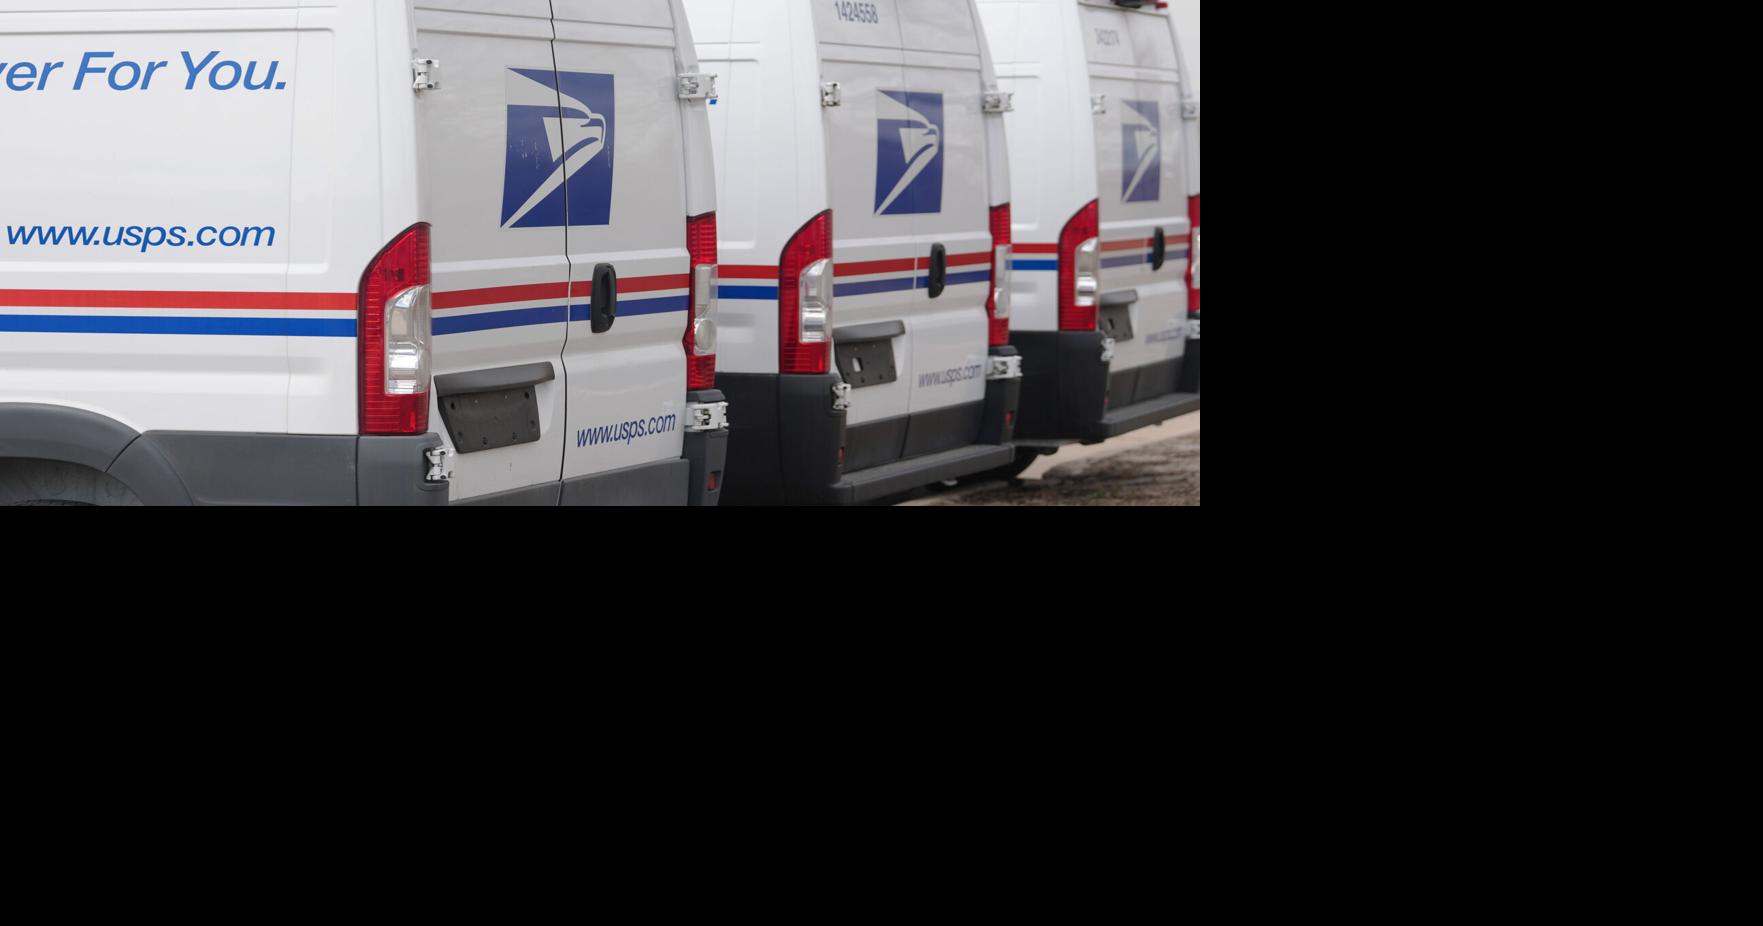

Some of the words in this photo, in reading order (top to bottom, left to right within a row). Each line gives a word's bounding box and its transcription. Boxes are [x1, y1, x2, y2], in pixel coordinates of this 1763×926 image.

[73, 51, 168, 91] For
[181, 51, 286, 91] You.
[7, 224, 276, 253] www.usps.com
[577, 413, 676, 448] www.usps.com
